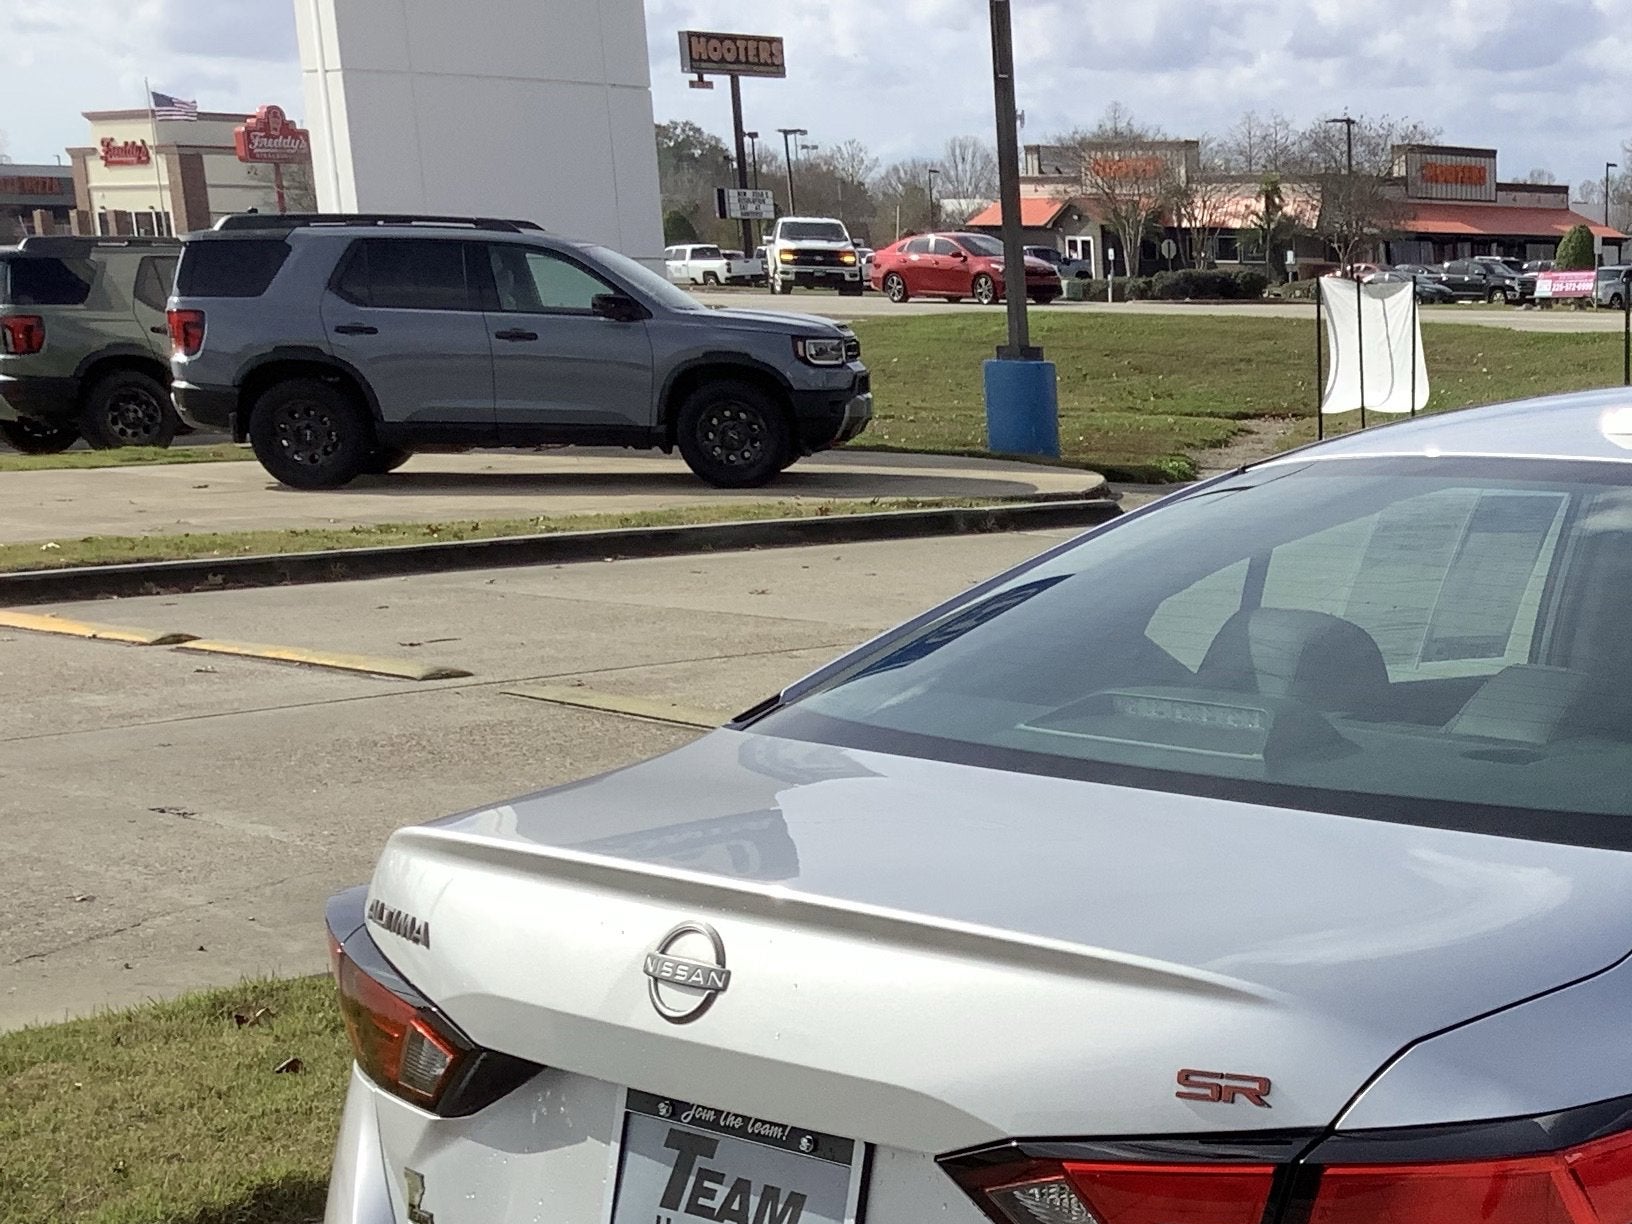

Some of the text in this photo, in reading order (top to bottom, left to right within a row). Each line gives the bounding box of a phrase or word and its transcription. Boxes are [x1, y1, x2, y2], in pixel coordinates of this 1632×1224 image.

[690, 36, 783, 65] HOOTERS
[249, 131, 308, 153] Freddy's
[367, 898, 431, 950] ALTIMA
[646, 955, 726, 988] NISSAN
[1175, 1068, 1272, 1109] SR
[681, 1102, 716, 1124] Join
